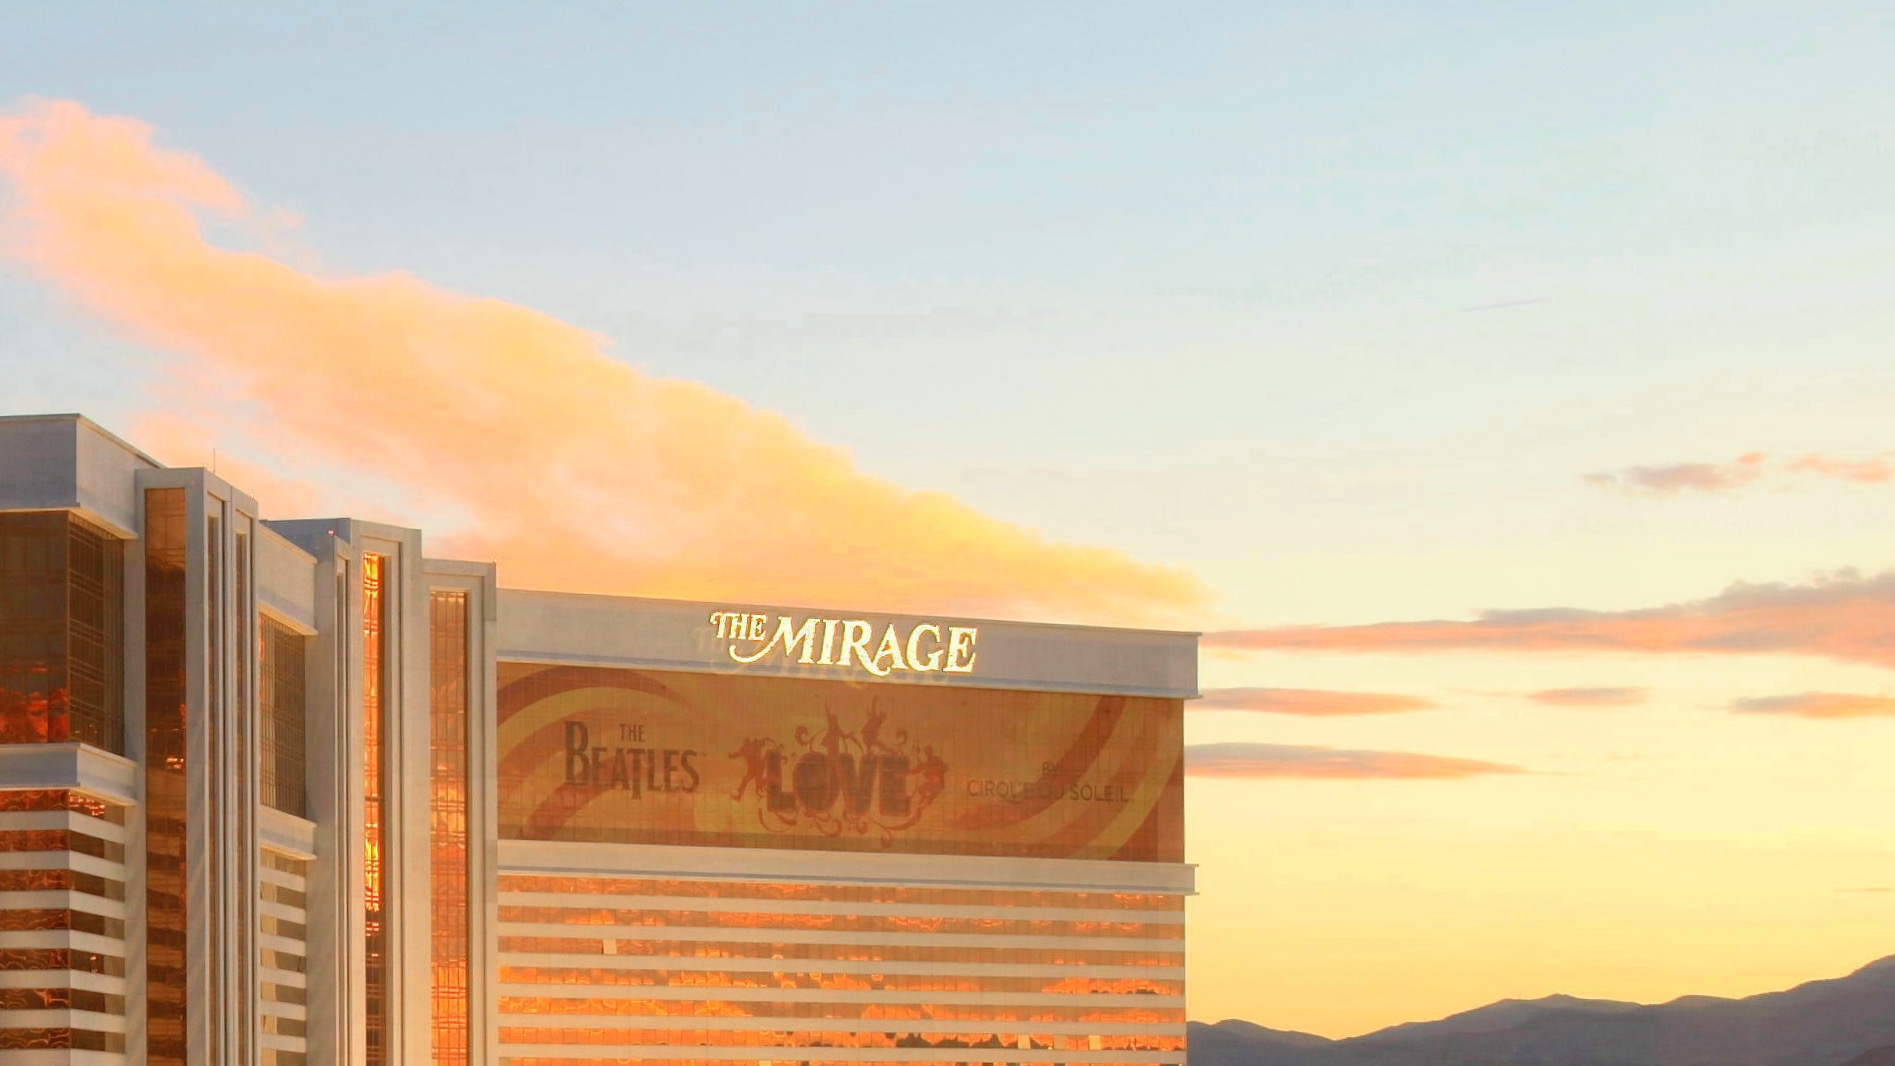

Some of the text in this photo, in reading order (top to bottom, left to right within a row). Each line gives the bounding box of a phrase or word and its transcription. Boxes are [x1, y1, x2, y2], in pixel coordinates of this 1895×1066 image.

[710, 612, 977, 676] THE MIRAGE
[565, 721, 700, 800] BEATLES
[619, 723, 646, 743] THE
[767, 750, 911, 816] LOVE
[967, 779, 1033, 803] CIRQUE
[1069, 783, 1129, 803] SOLEIL
